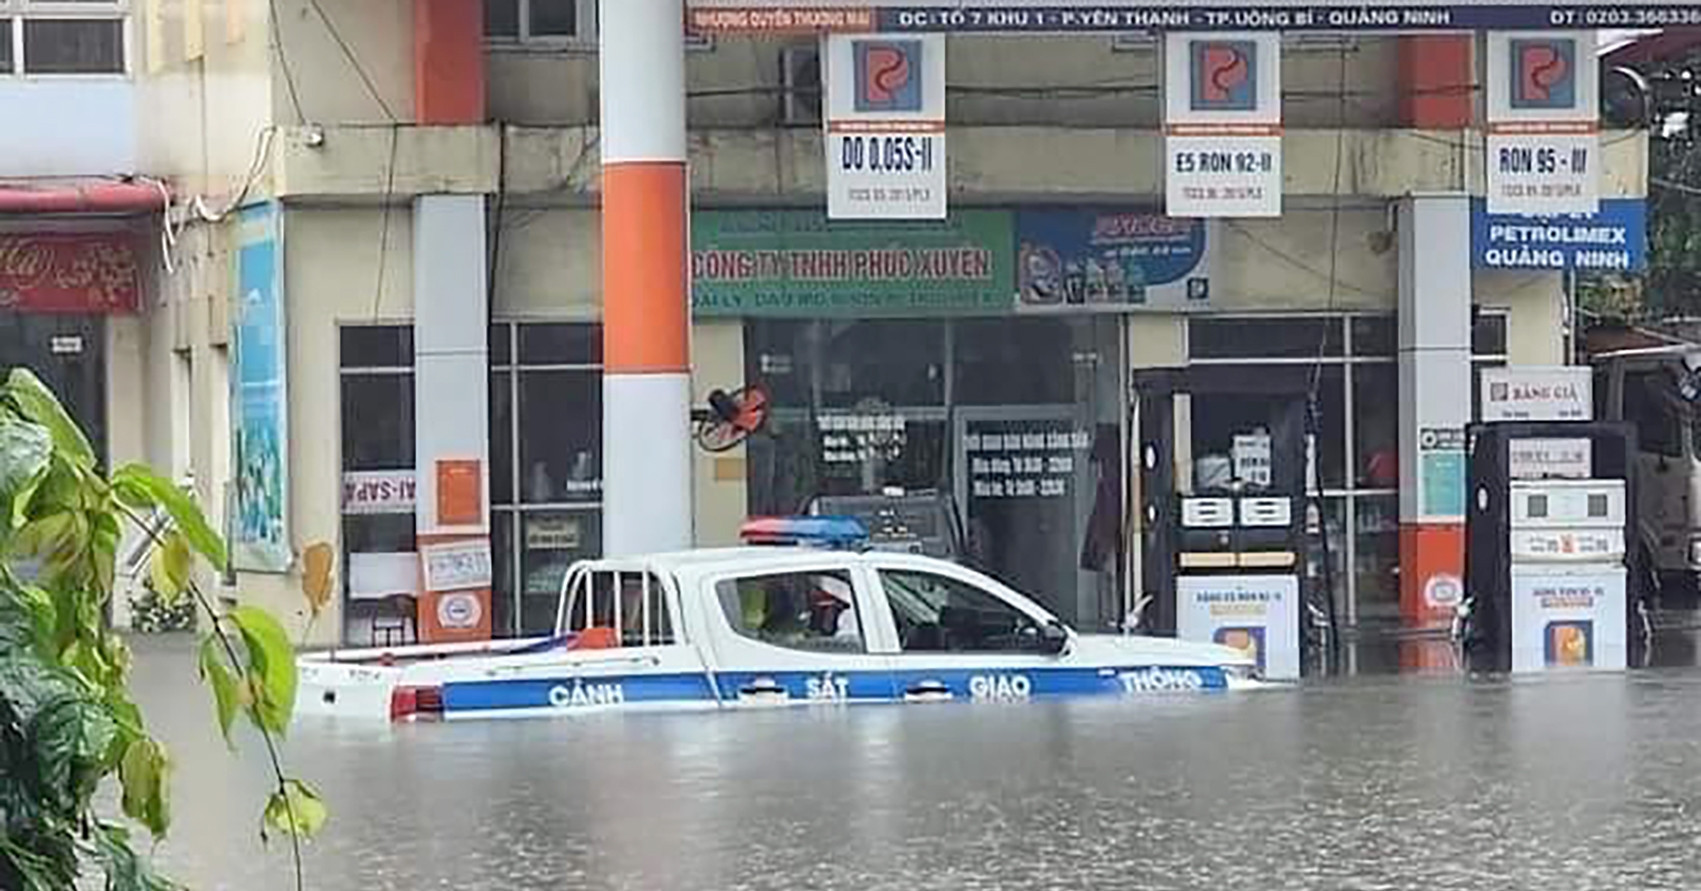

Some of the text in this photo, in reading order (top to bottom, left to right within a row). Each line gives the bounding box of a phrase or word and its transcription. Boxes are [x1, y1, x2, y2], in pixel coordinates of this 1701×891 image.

[1404, 10, 1450, 25] NINH
[1176, 152, 1195, 172] E5
[1199, 152, 1232, 172] RON
[1499, 148, 1532, 172] RON
[1537, 148, 1556, 172] 95
[1571, 148, 1587, 173] III
[1489, 225, 1627, 244] PETROLIMEX
[755, 251, 779, 280] TY
[791, 250, 849, 280] TNHH
[1485, 244, 1630, 268] QUẢNG NINH
[549, 667, 1203, 706] CẢNH SÁT GIAO THÔNG
